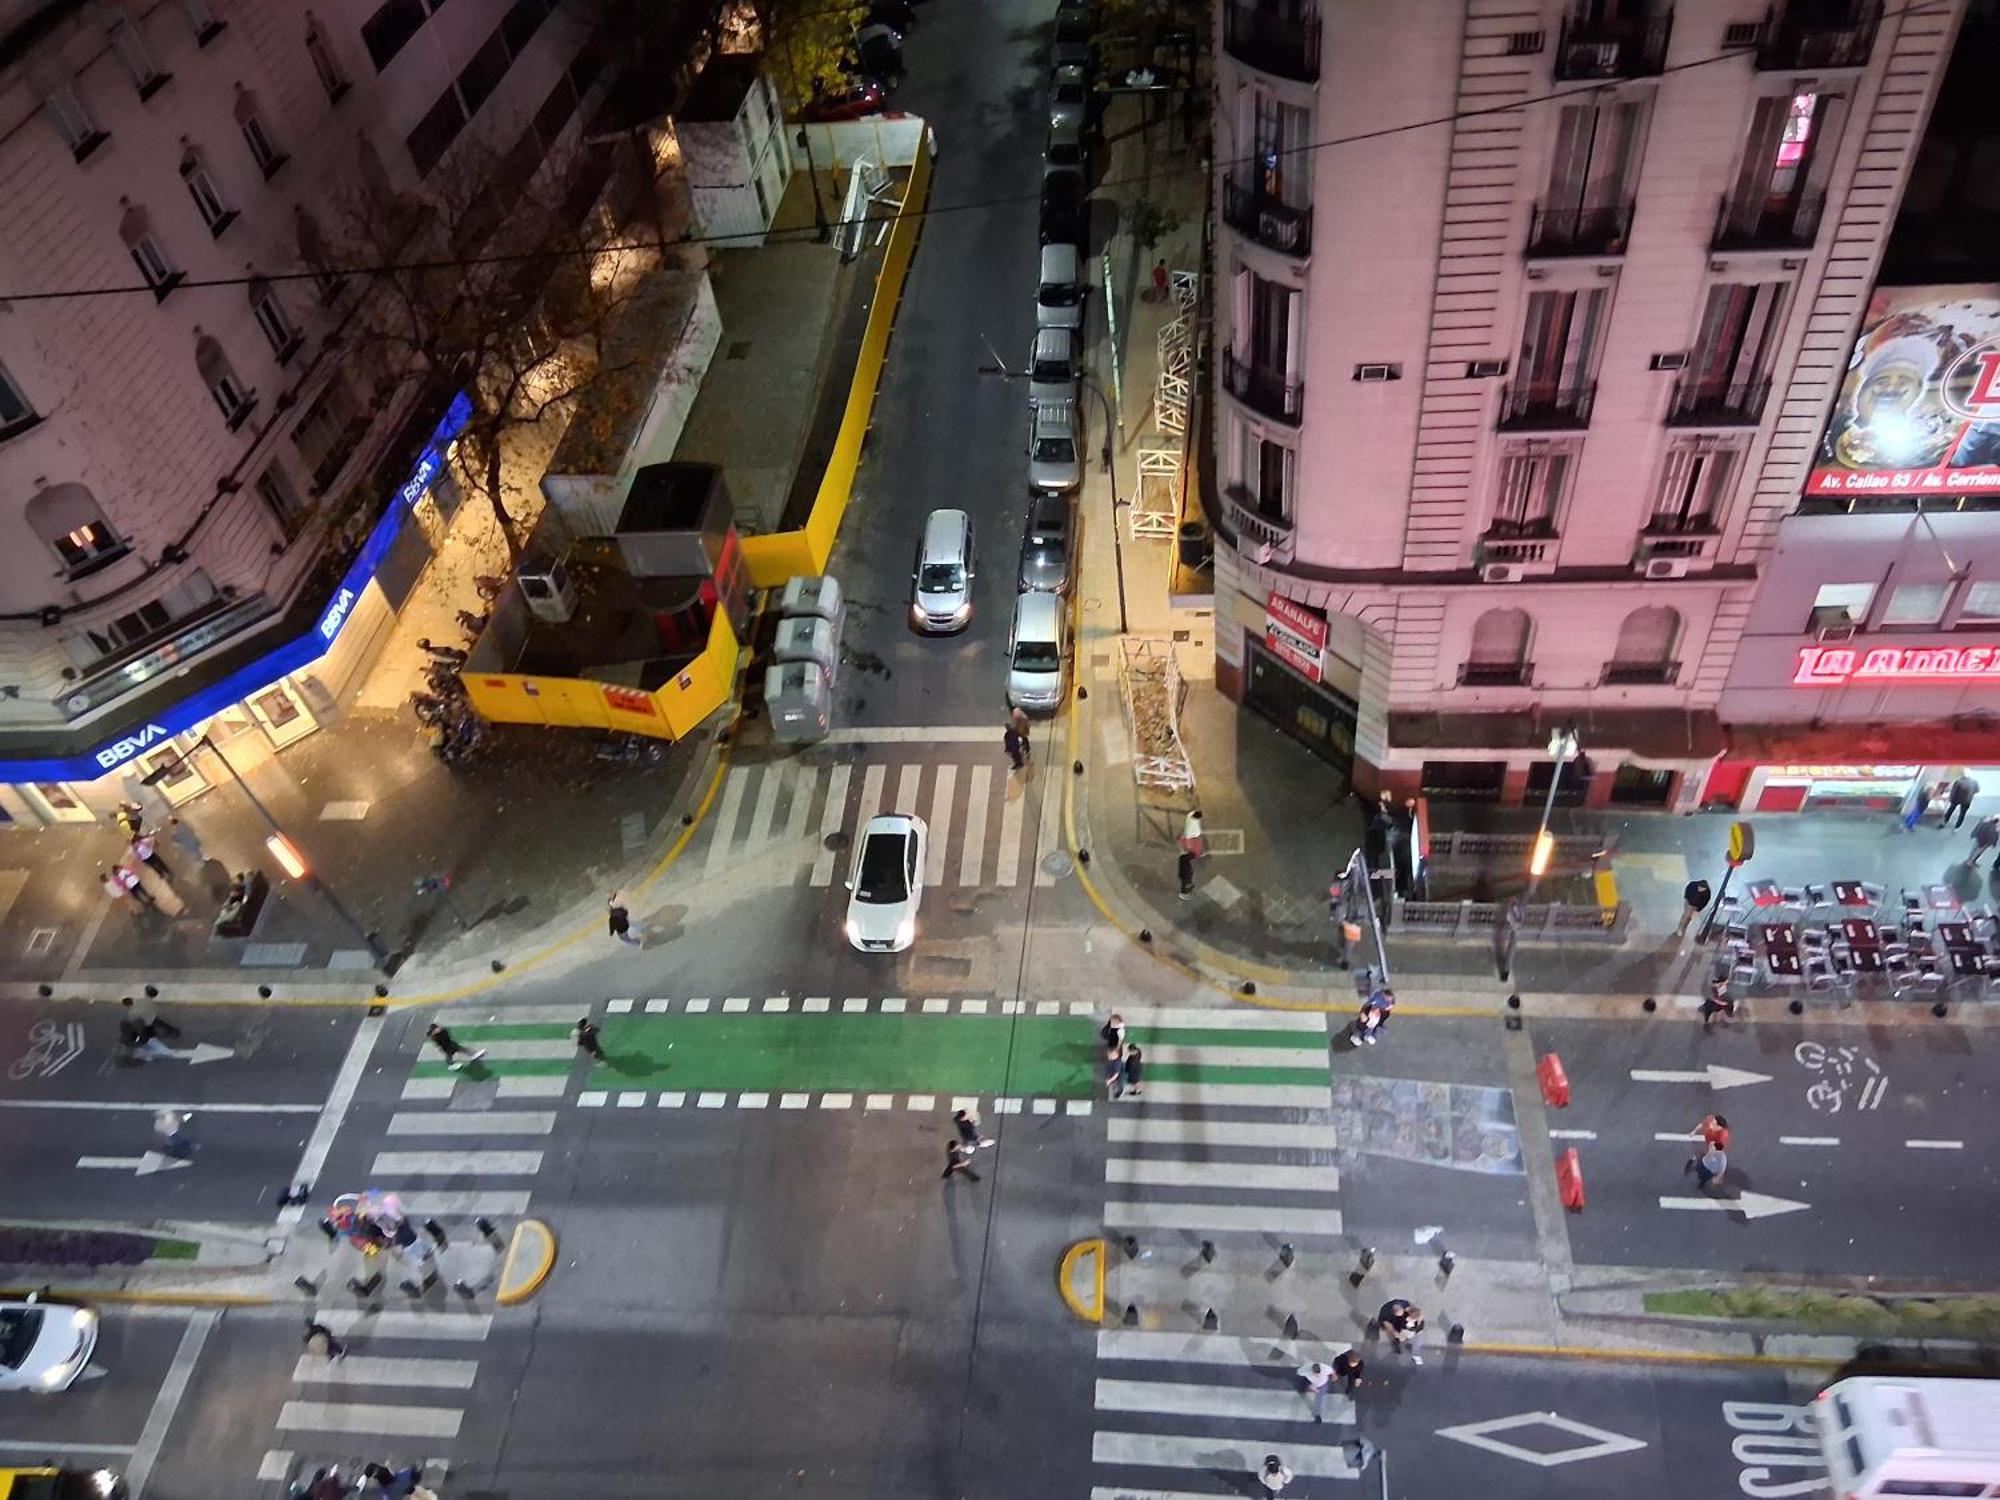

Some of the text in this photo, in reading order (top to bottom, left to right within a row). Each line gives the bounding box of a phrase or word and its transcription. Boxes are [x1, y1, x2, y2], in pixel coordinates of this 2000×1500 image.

[1820, 473, 1842, 488] Av.
[1846, 473, 1889, 488] Callao
[320, 588, 354, 640] BBVA
[95, 723, 168, 769] BBVA
